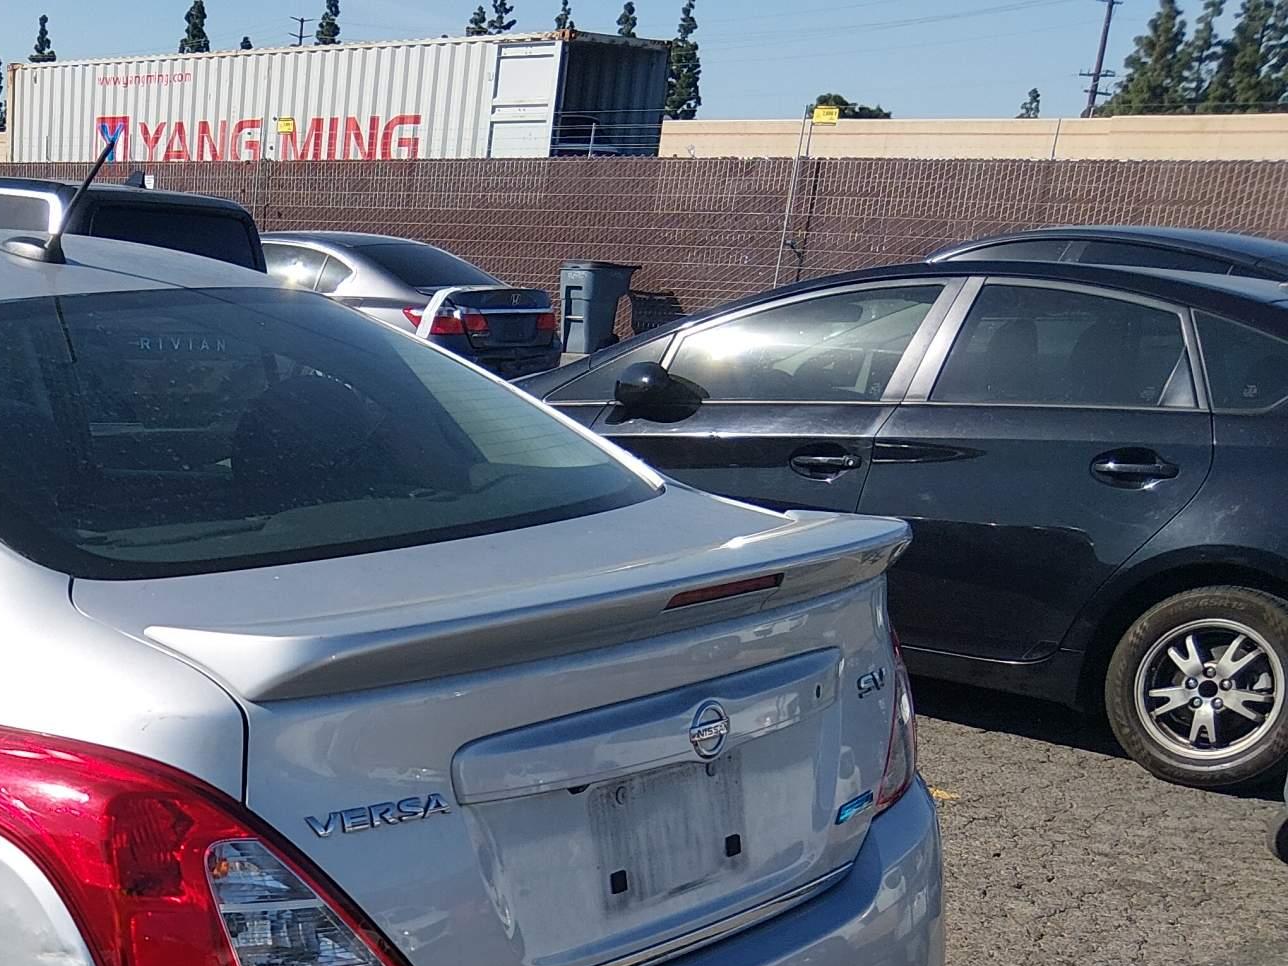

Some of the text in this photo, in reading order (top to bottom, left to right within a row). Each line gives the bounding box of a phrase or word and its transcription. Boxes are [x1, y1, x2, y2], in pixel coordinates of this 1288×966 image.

[97, 71, 192, 88] www.yangming.com
[138, 114, 422, 161] YANG MING
[139, 336, 226, 352] RIVIAN
[304, 792, 451, 838] VERSA
